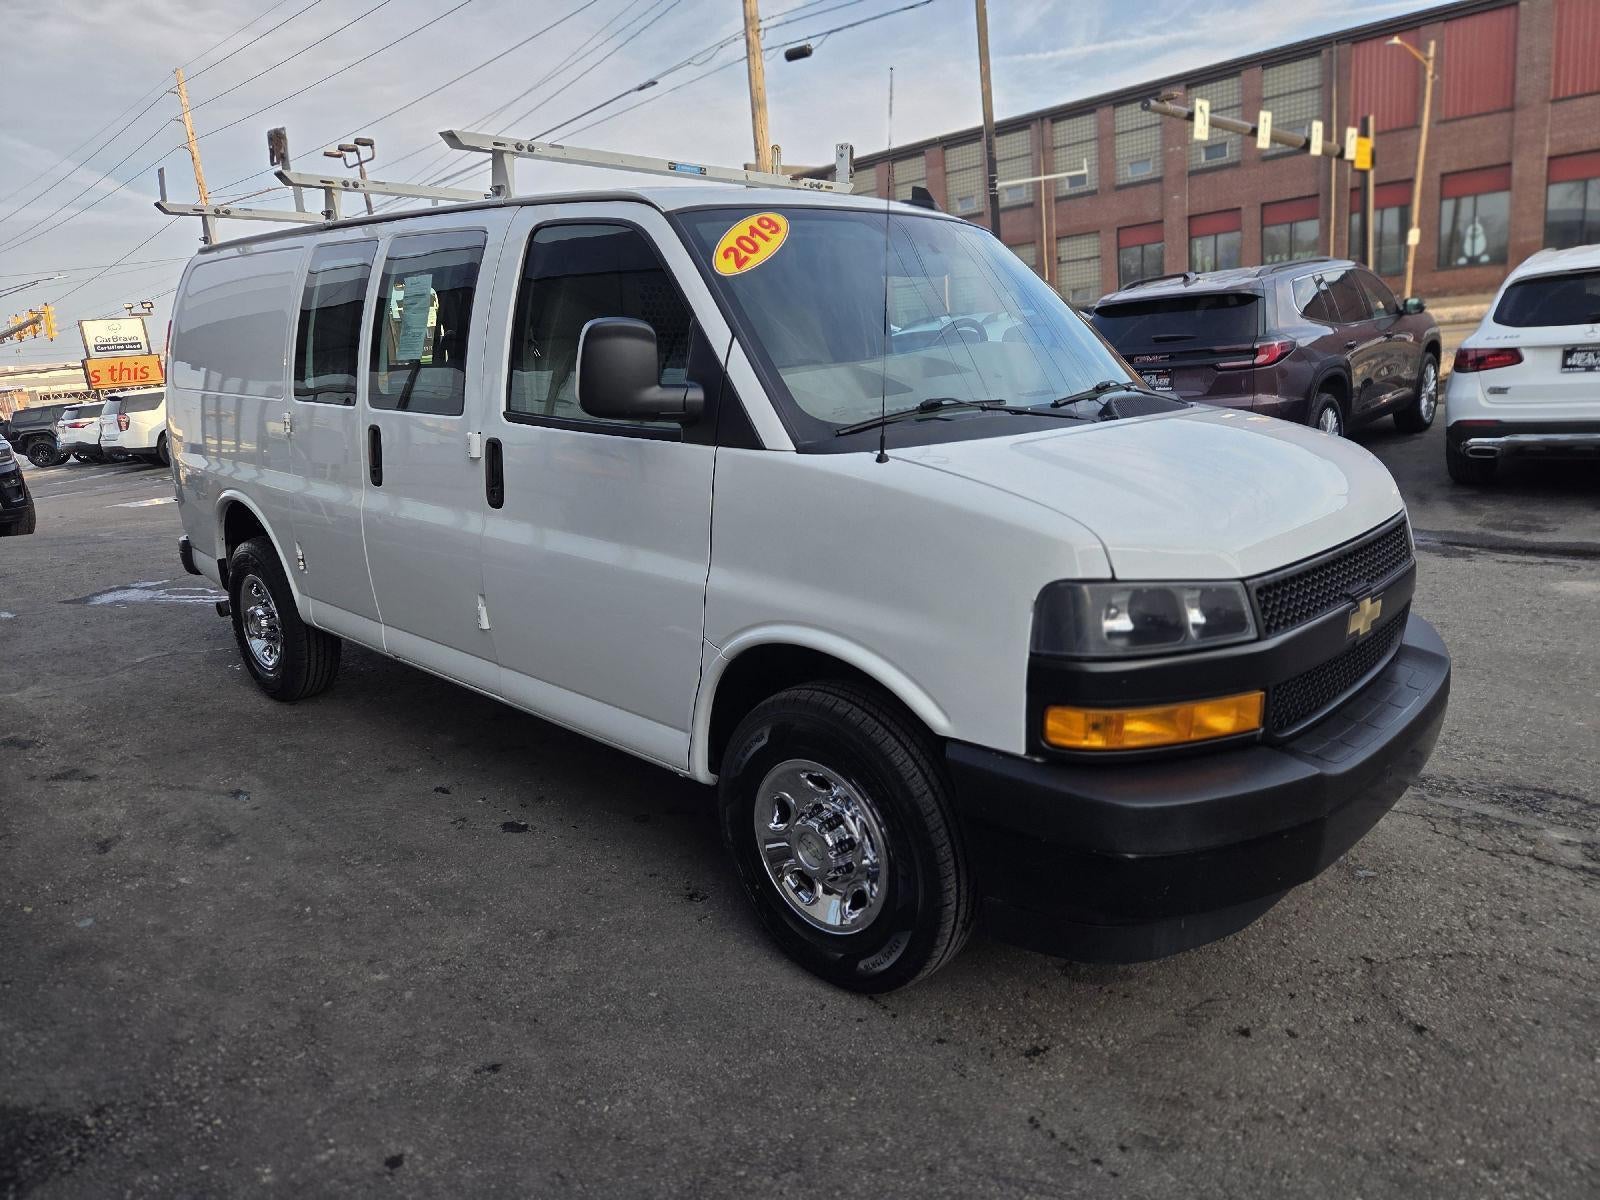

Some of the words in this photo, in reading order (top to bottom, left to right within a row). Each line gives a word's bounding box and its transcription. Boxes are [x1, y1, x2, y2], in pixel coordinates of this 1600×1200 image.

[722, 215, 781, 270] 2019
[95, 335, 139, 343] CarBravo
[91, 369, 101, 384] s
[108, 361, 150, 383] this
